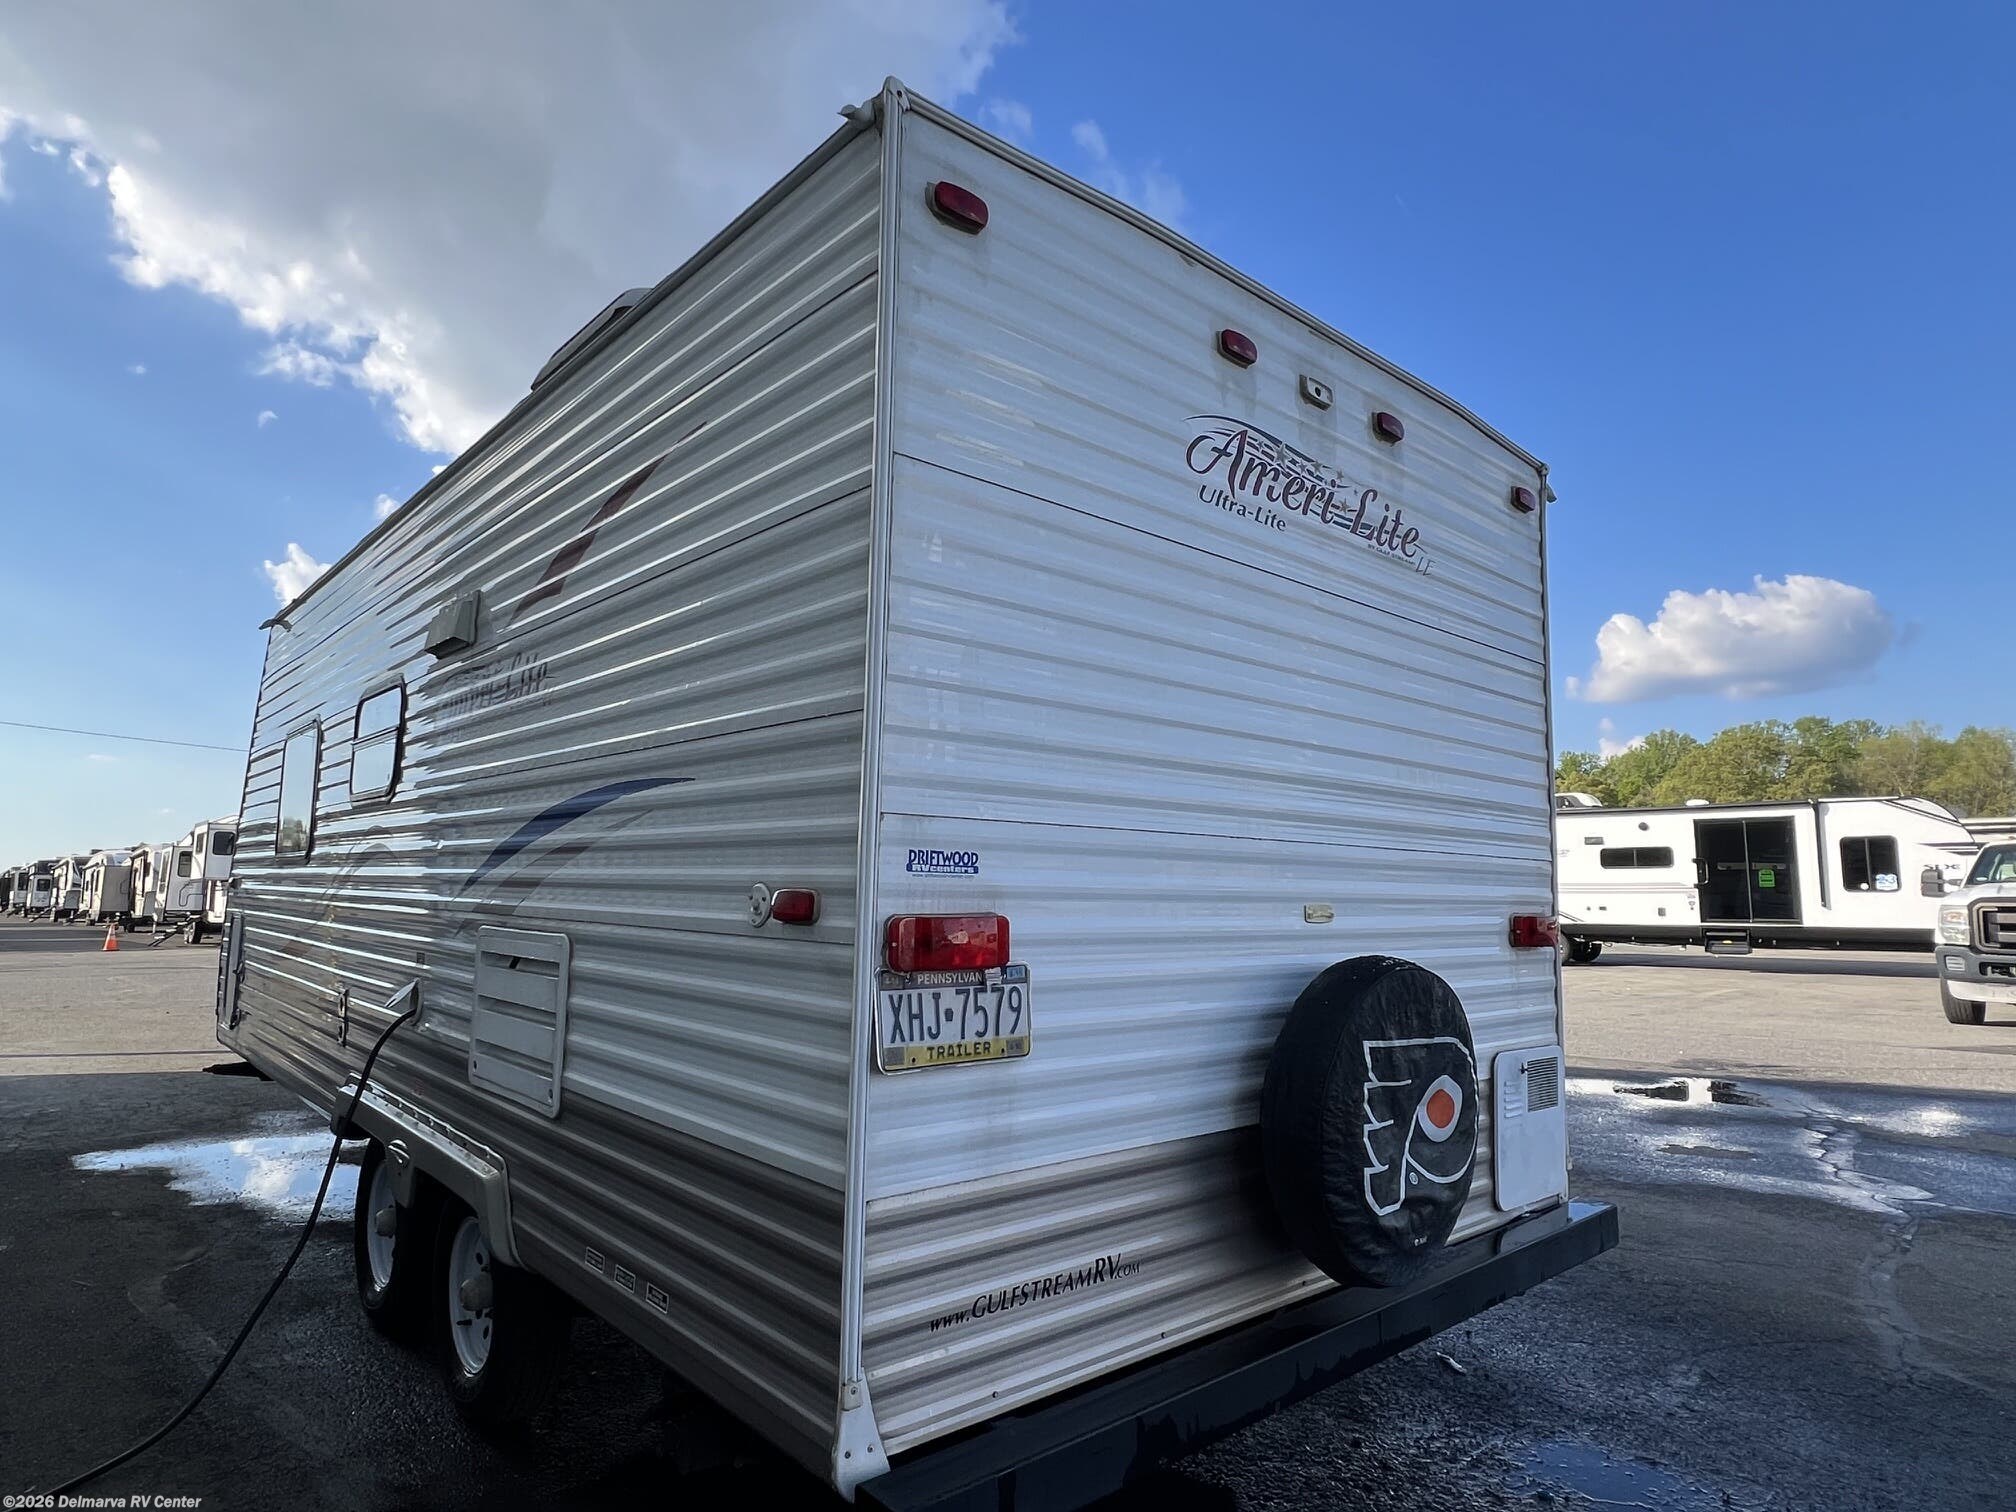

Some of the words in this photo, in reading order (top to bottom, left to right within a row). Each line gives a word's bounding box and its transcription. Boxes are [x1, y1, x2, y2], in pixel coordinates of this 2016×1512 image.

[1199, 485, 1287, 532] Ultra-Lite
[1415, 556, 1436, 576] LE
[909, 849, 978, 865] DRIFTWOOD
[917, 971, 985, 985] PENNSYLVAN
[927, 1042, 991, 1060] TRAILER
